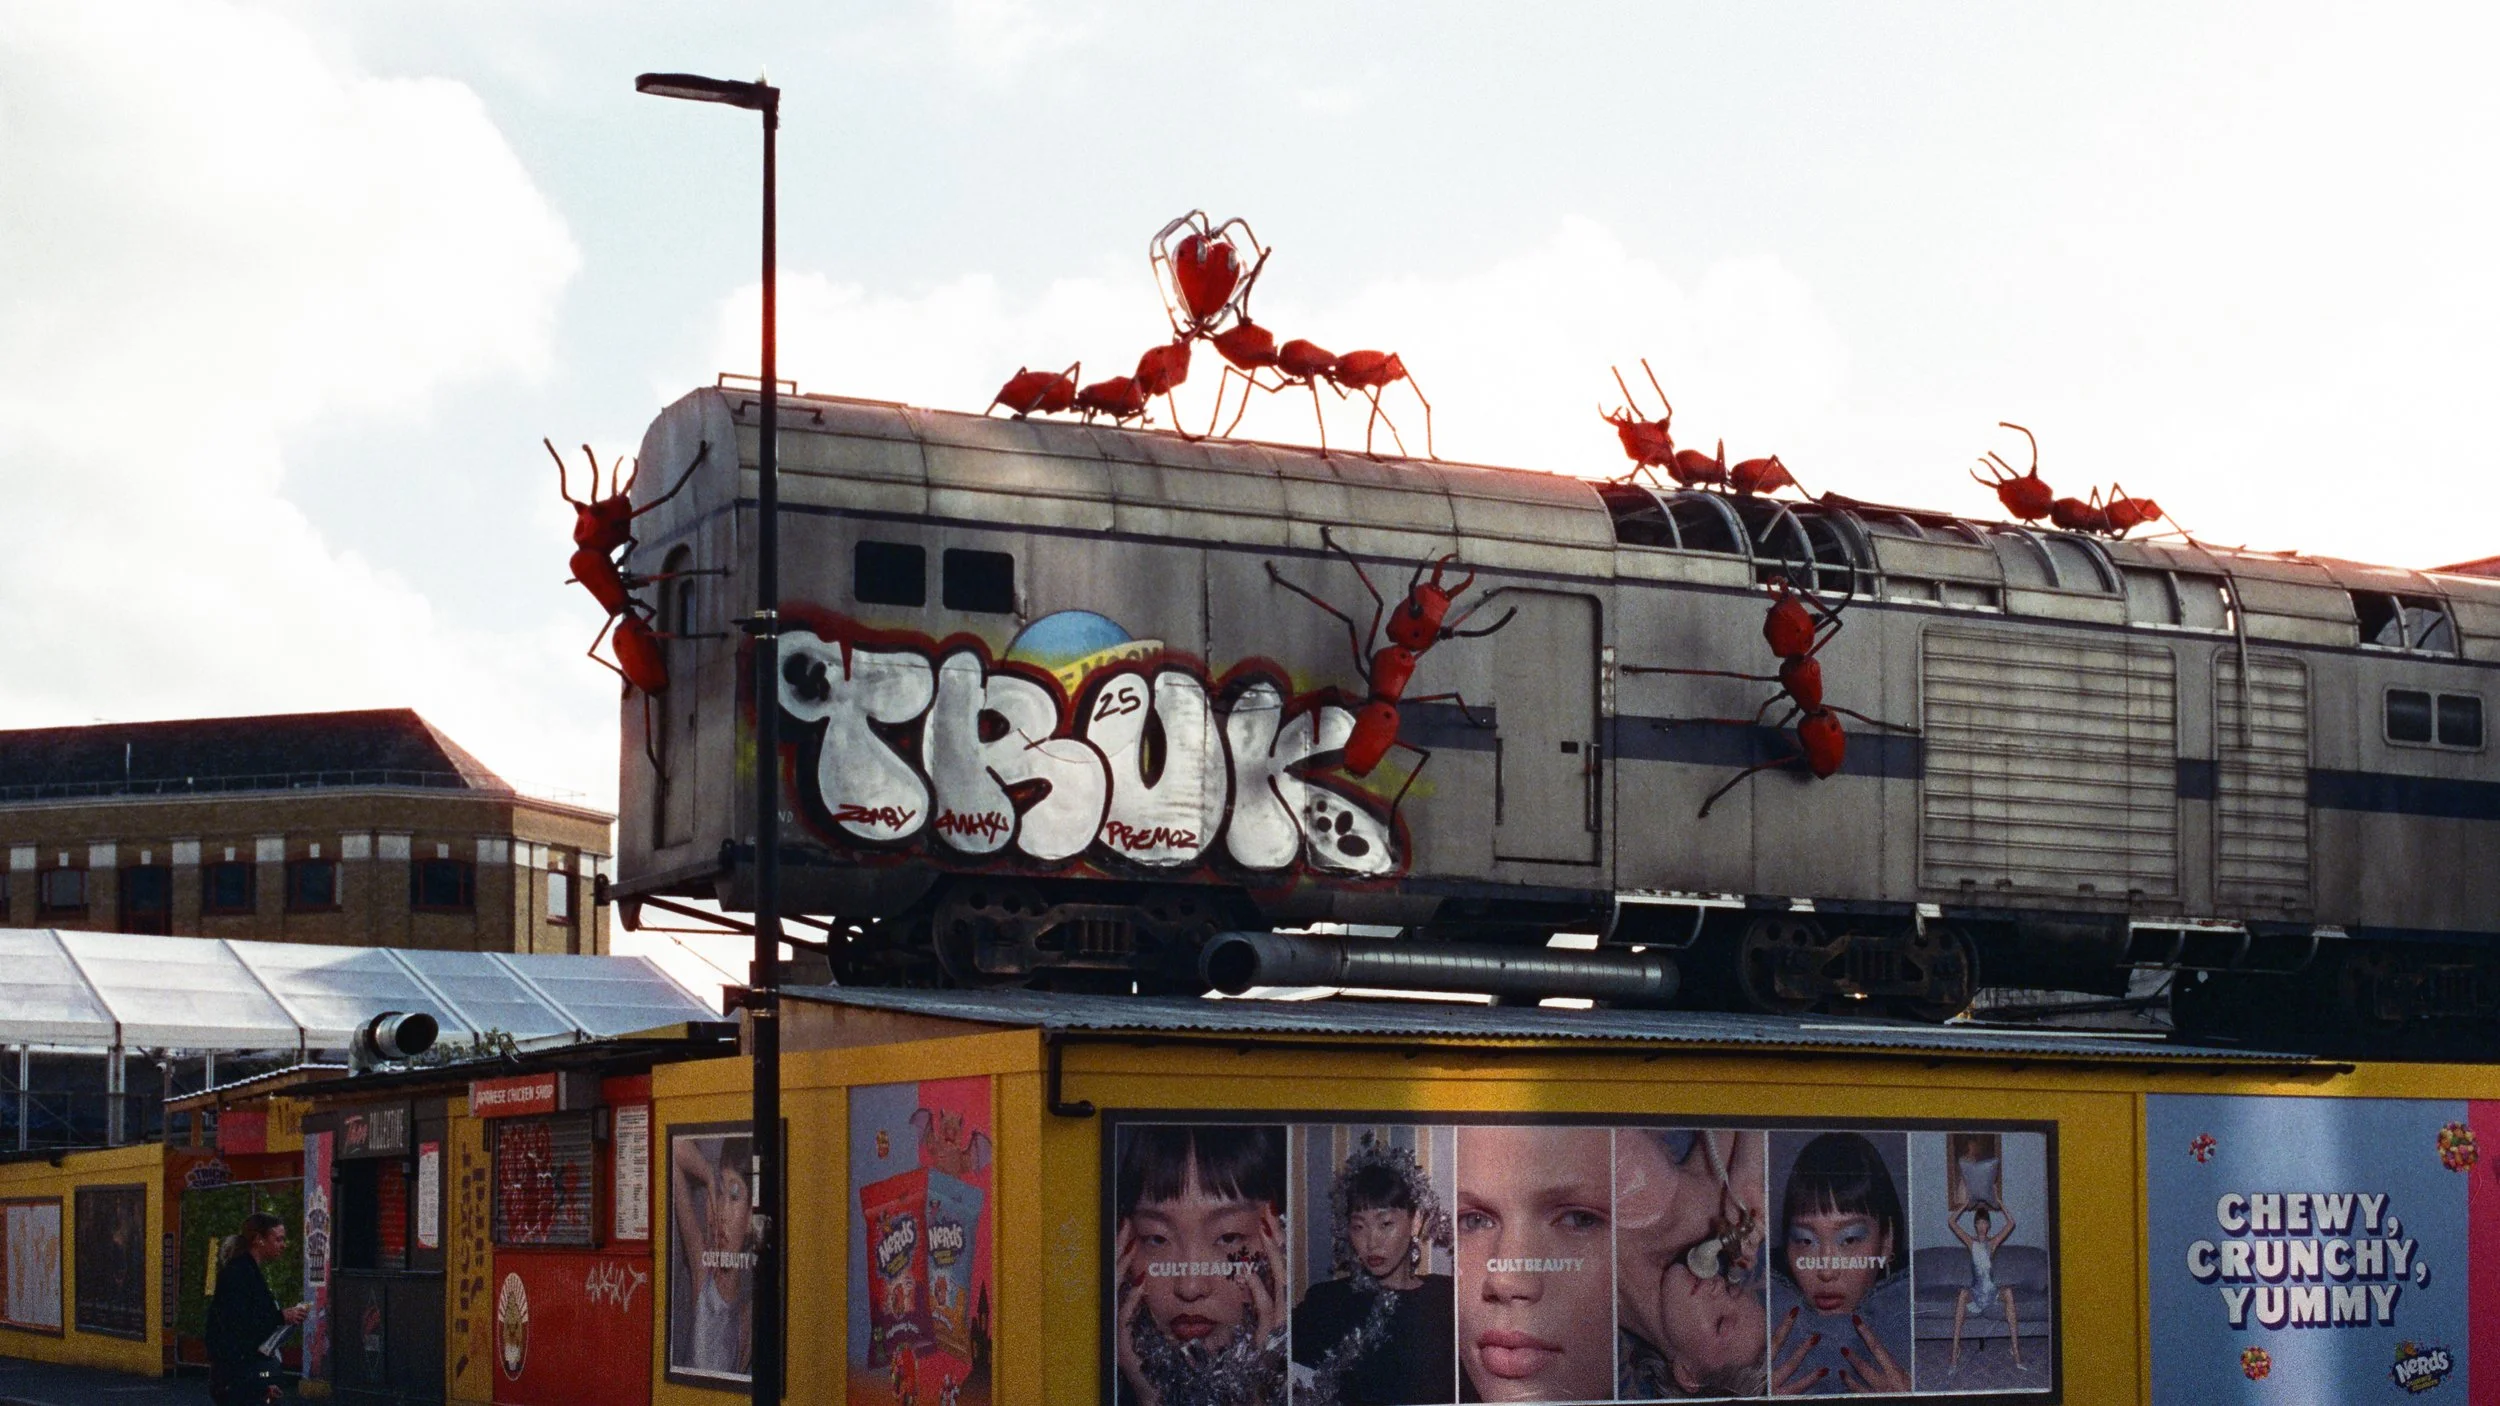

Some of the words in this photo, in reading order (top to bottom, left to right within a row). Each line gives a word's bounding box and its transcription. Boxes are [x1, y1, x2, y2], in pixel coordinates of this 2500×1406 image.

[1093, 686, 1142, 722] 25
[2216, 1192, 2403, 1238] CHEWY,
[702, 1251, 720, 1268] CULT
[720, 1252, 750, 1269] BEAUTY
[1147, 1261, 1188, 1277] CULT
[1189, 1261, 1256, 1276] BEAUTY
[1486, 1258, 1523, 1272] CULT
[1524, 1257, 1585, 1272] BEAUTY
[1796, 1256, 1829, 1270] CULT
[1831, 1255, 1887, 1270] BEAUTY
[2186, 1238, 2431, 1289] CRUNCHY,
[2218, 1283, 2401, 1330] YUMMY
